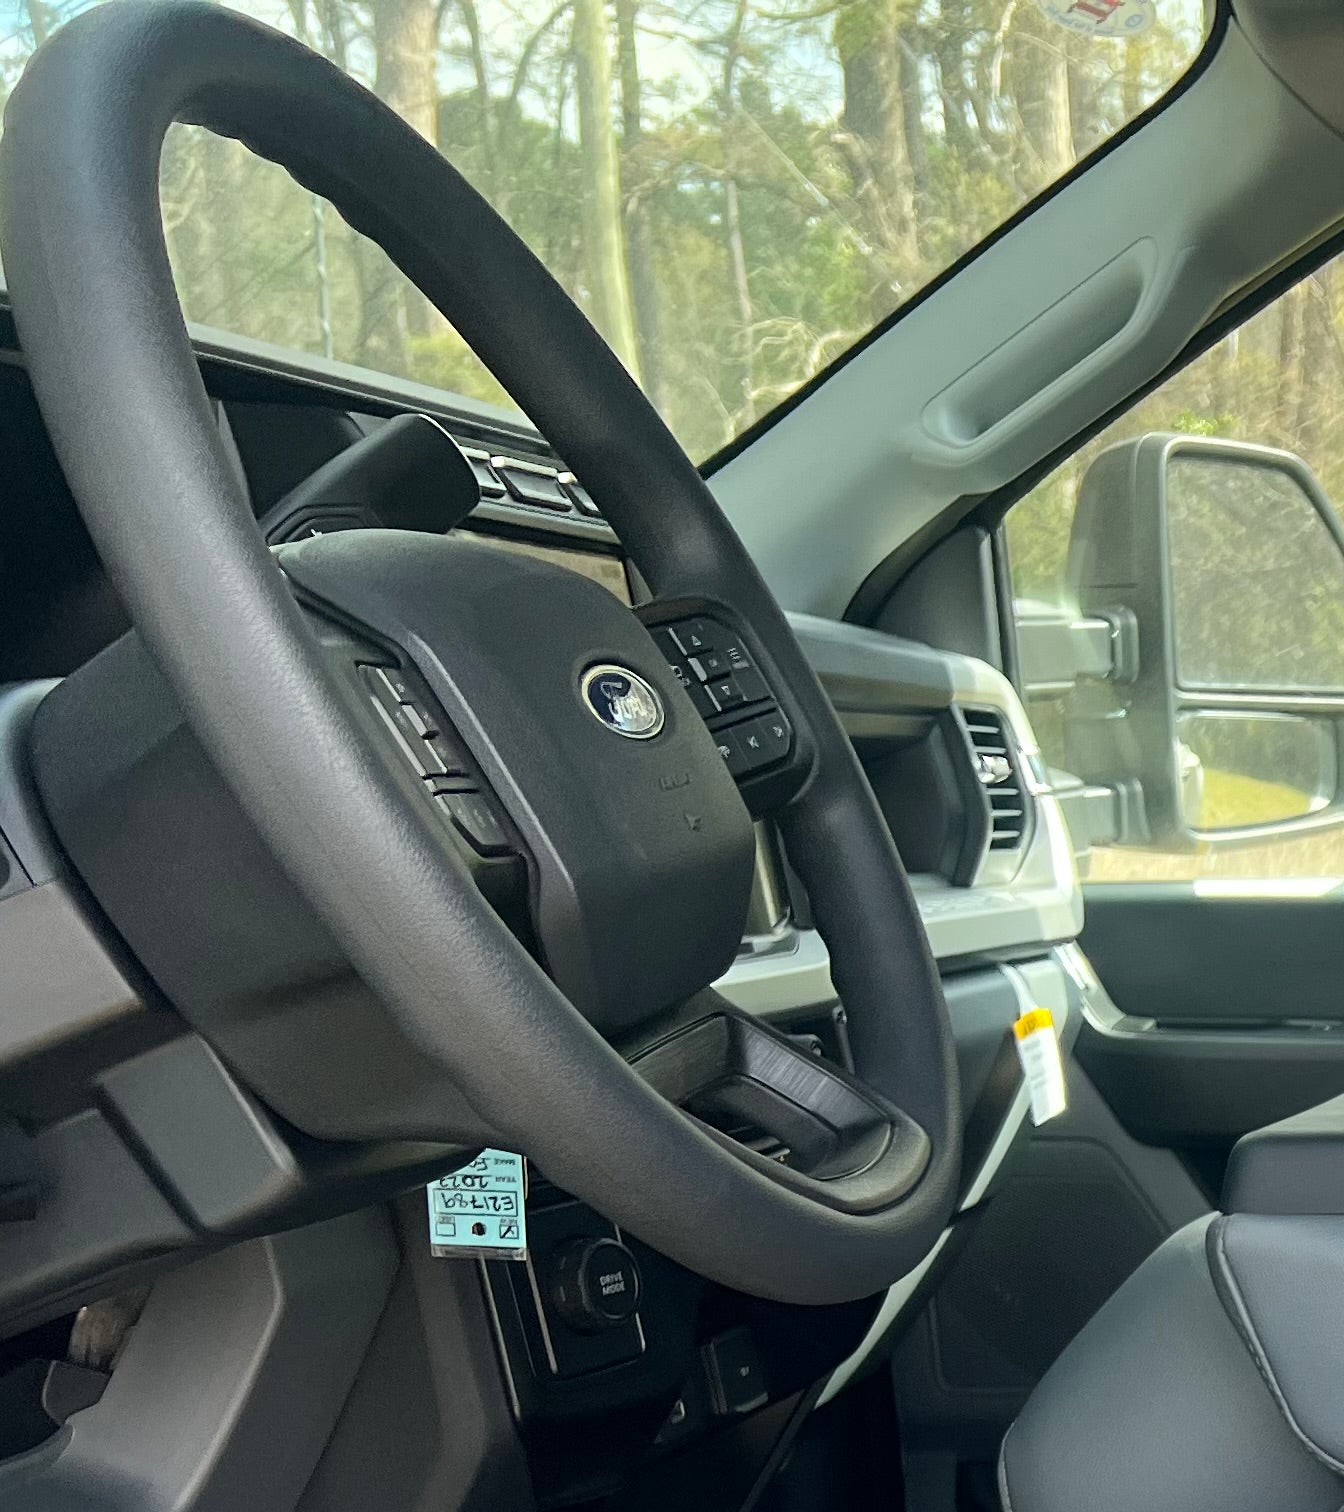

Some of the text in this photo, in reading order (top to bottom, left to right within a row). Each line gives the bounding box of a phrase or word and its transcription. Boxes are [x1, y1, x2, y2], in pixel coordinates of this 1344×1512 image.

[441, 1192, 515, 1212] E21789
[600, 1271, 624, 1286] DRIVE
[602, 1281, 626, 1296] MODE
